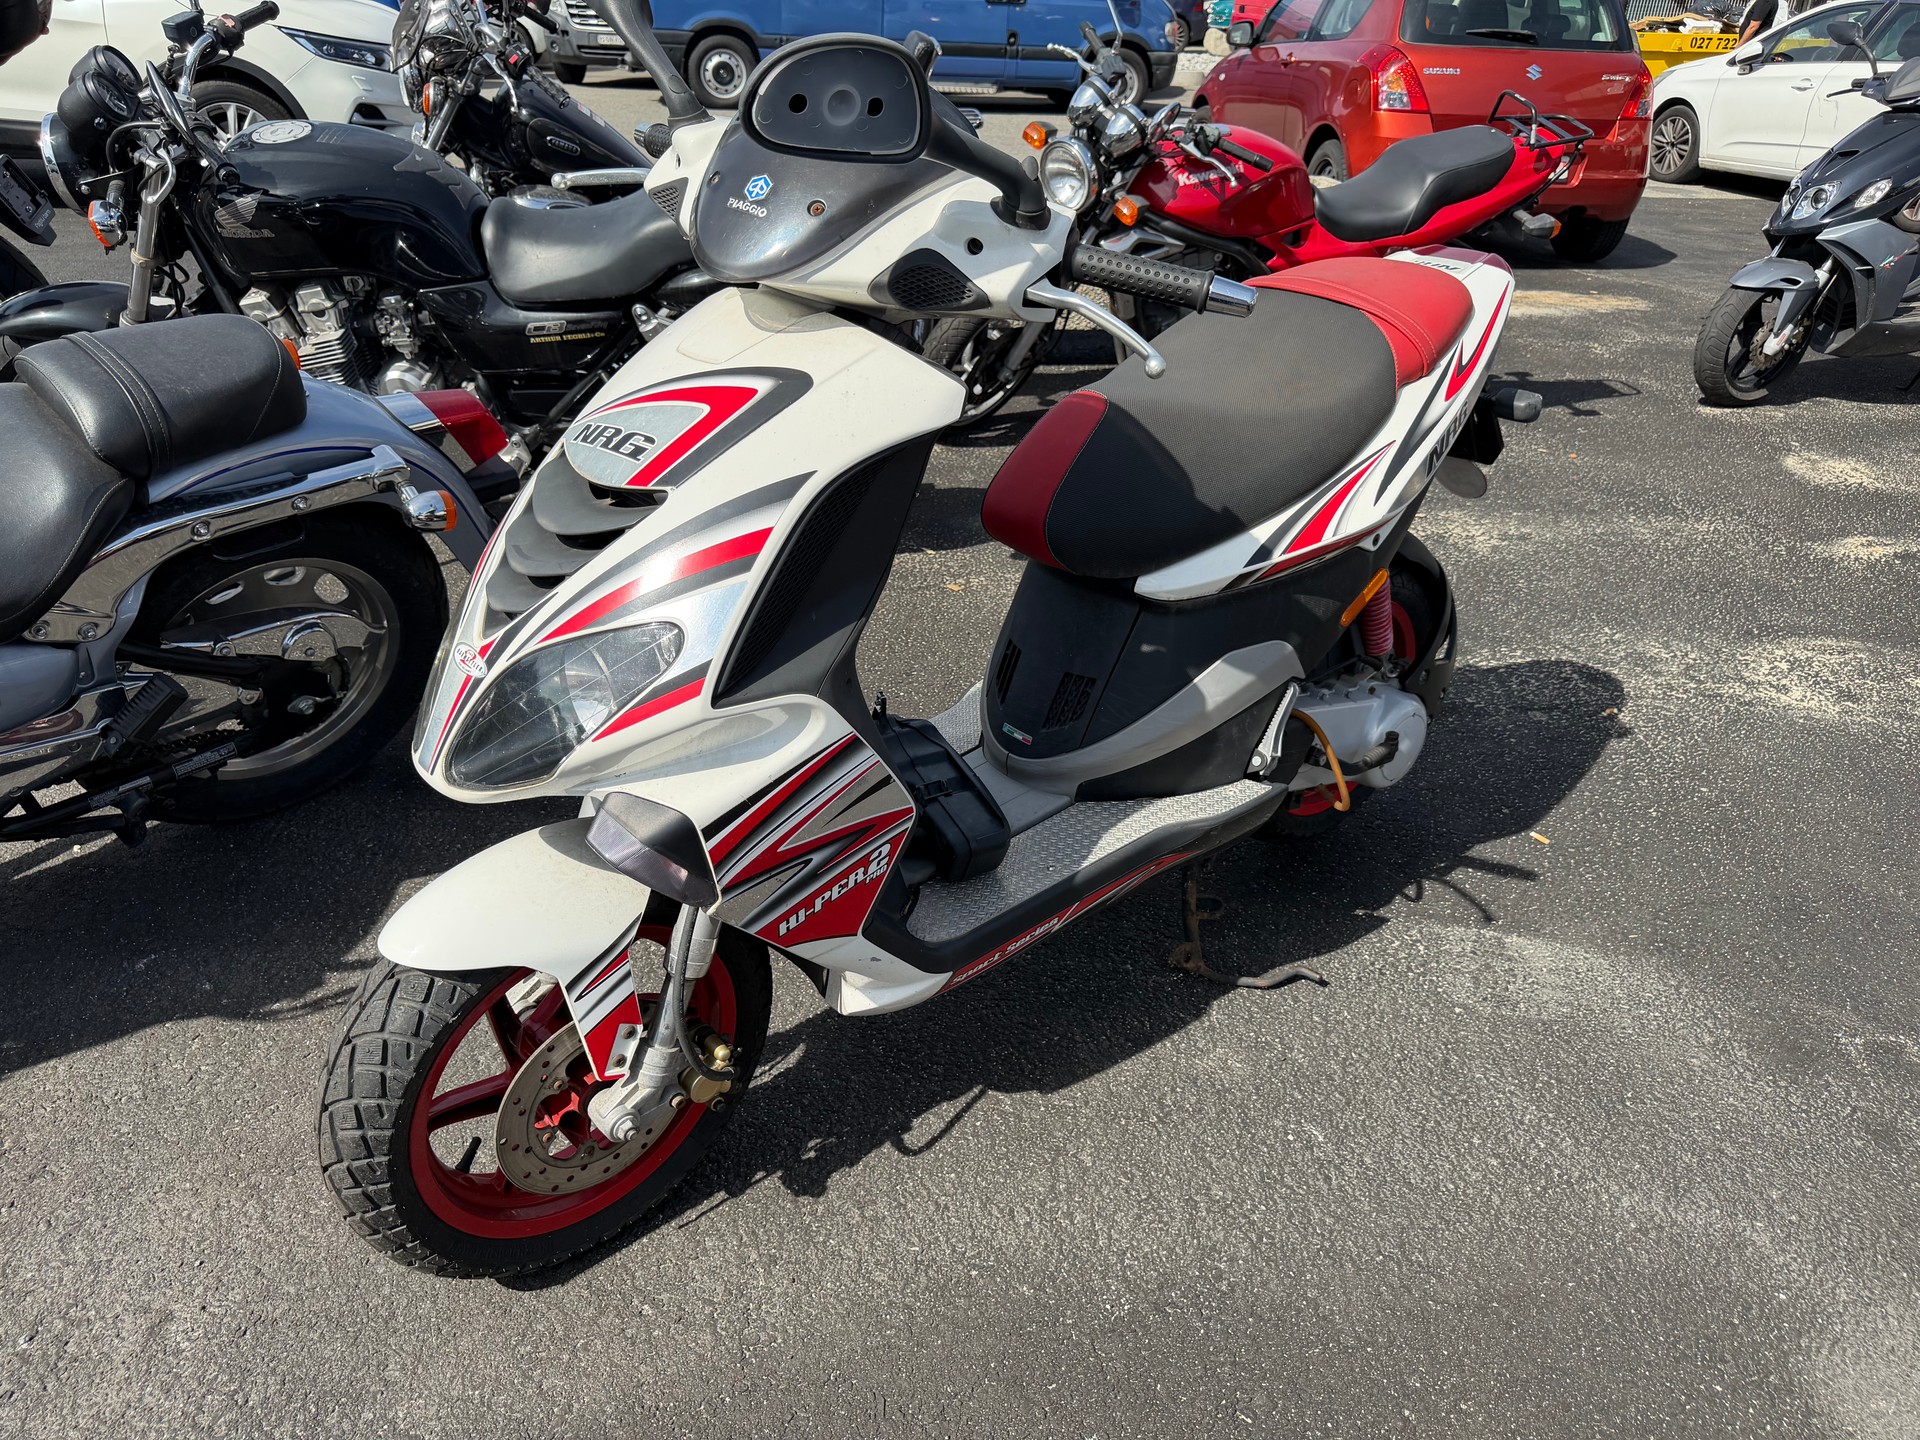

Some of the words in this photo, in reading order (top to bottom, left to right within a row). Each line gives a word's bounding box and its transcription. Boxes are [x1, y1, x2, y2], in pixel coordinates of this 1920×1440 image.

[1690, 36, 1713, 50] 027
[1423, 67, 1460, 75] SUZUKI
[727, 197, 768, 217] PIAGGIO
[220, 228, 275, 239] HONDA
[525, 320, 567, 335] CB
[530, 335, 562, 344] ARTHUR
[570, 422, 658, 464] NRG
[1425, 400, 1468, 480] NRG
[865, 863, 888, 885] PRO
